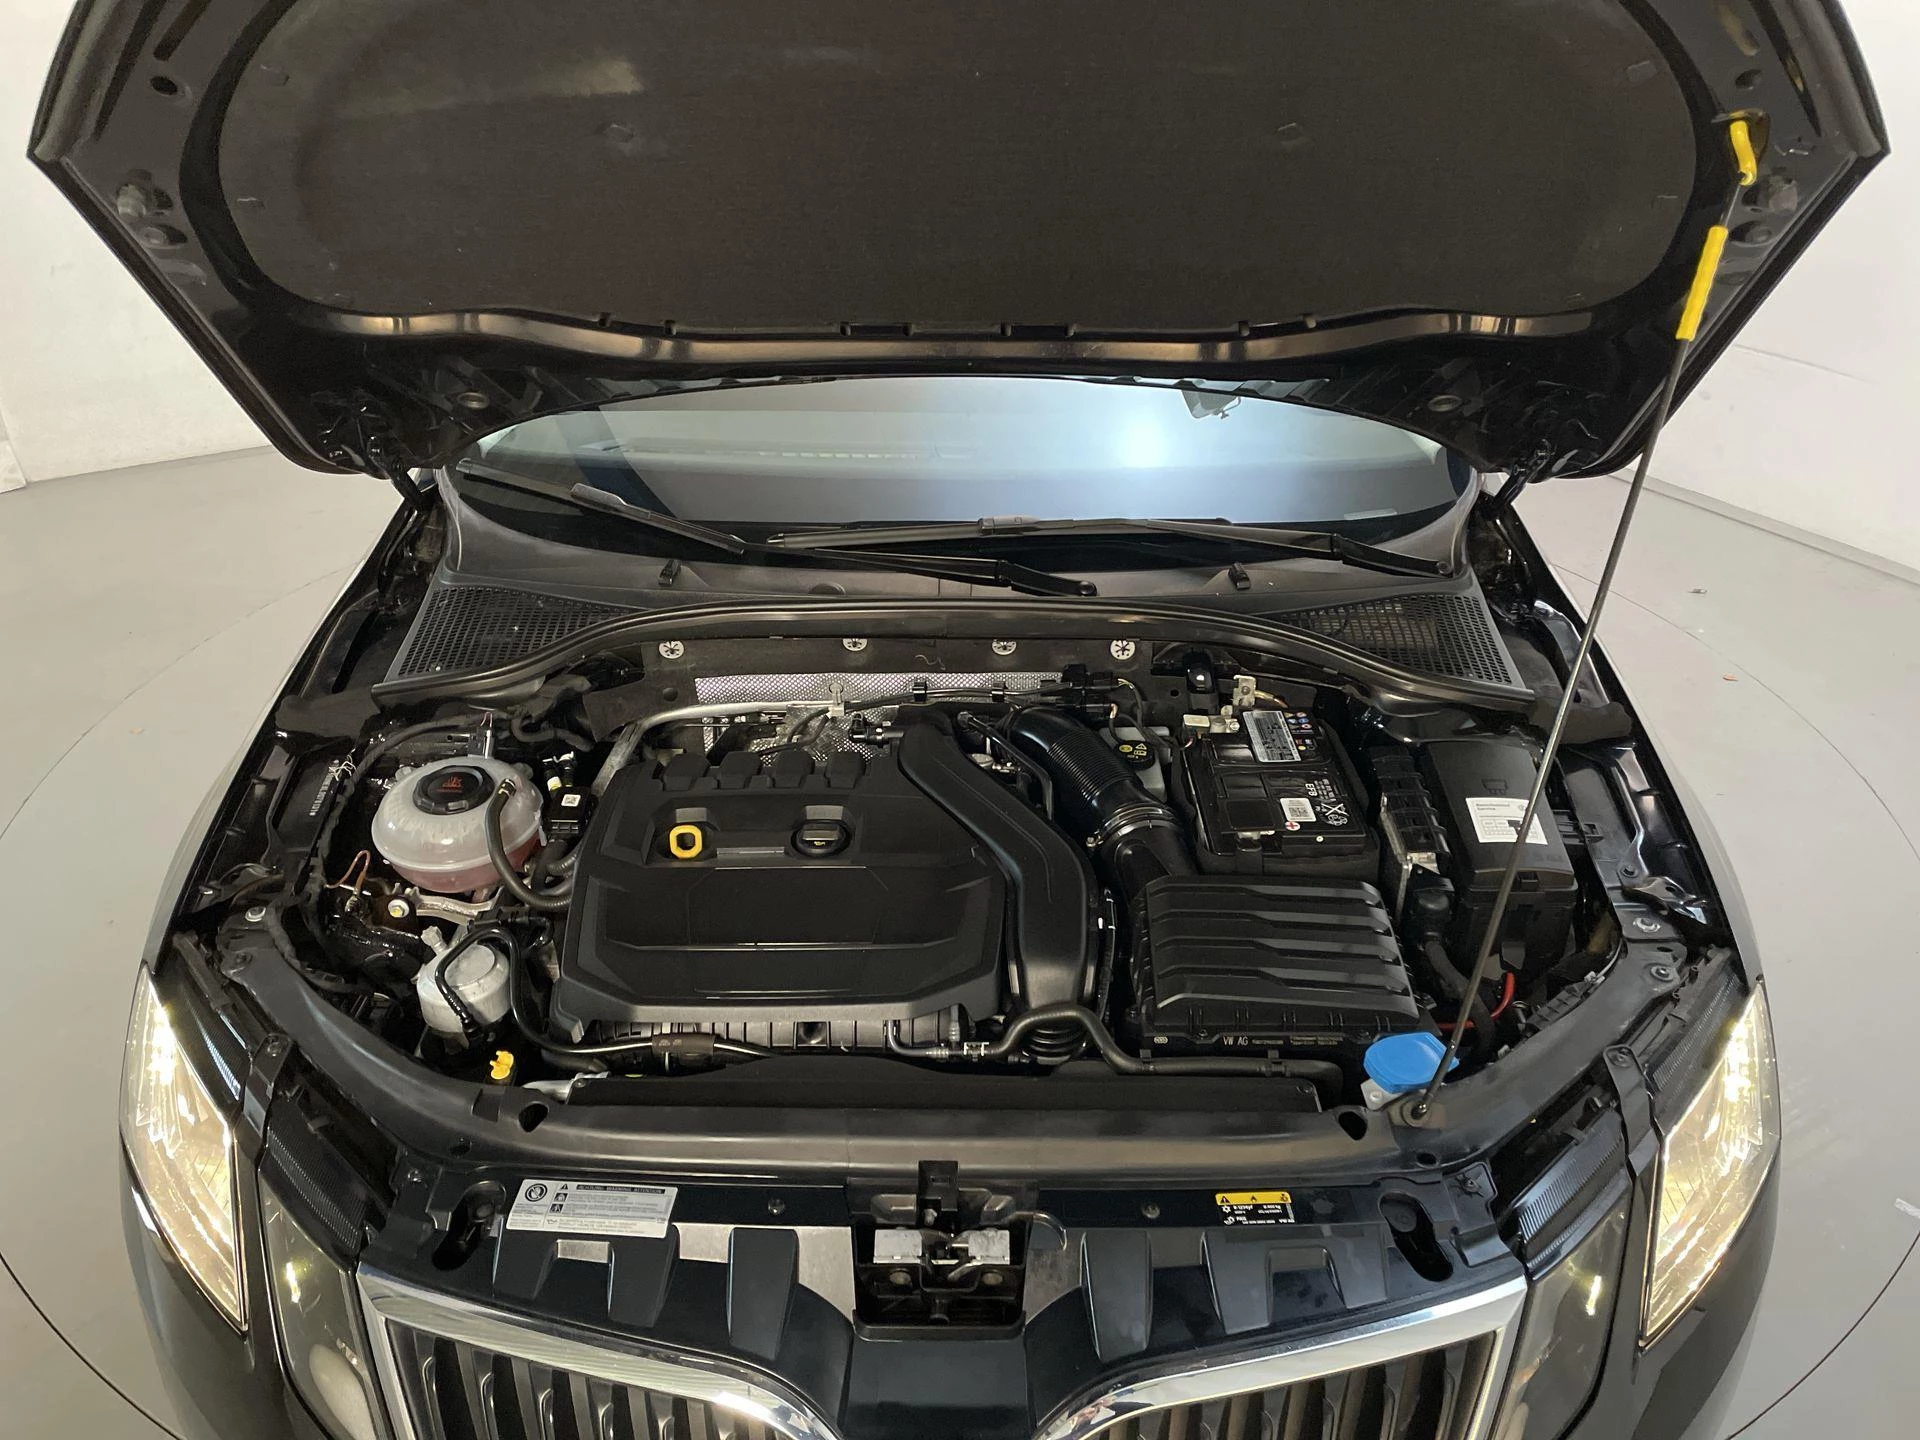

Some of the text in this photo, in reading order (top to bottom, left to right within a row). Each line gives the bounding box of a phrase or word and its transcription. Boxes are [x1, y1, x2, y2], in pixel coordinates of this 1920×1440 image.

[1305, 783, 1318, 797] EFB
[1223, 1036, 1234, 1045] VW
[1237, 1036, 1248, 1046] AG
